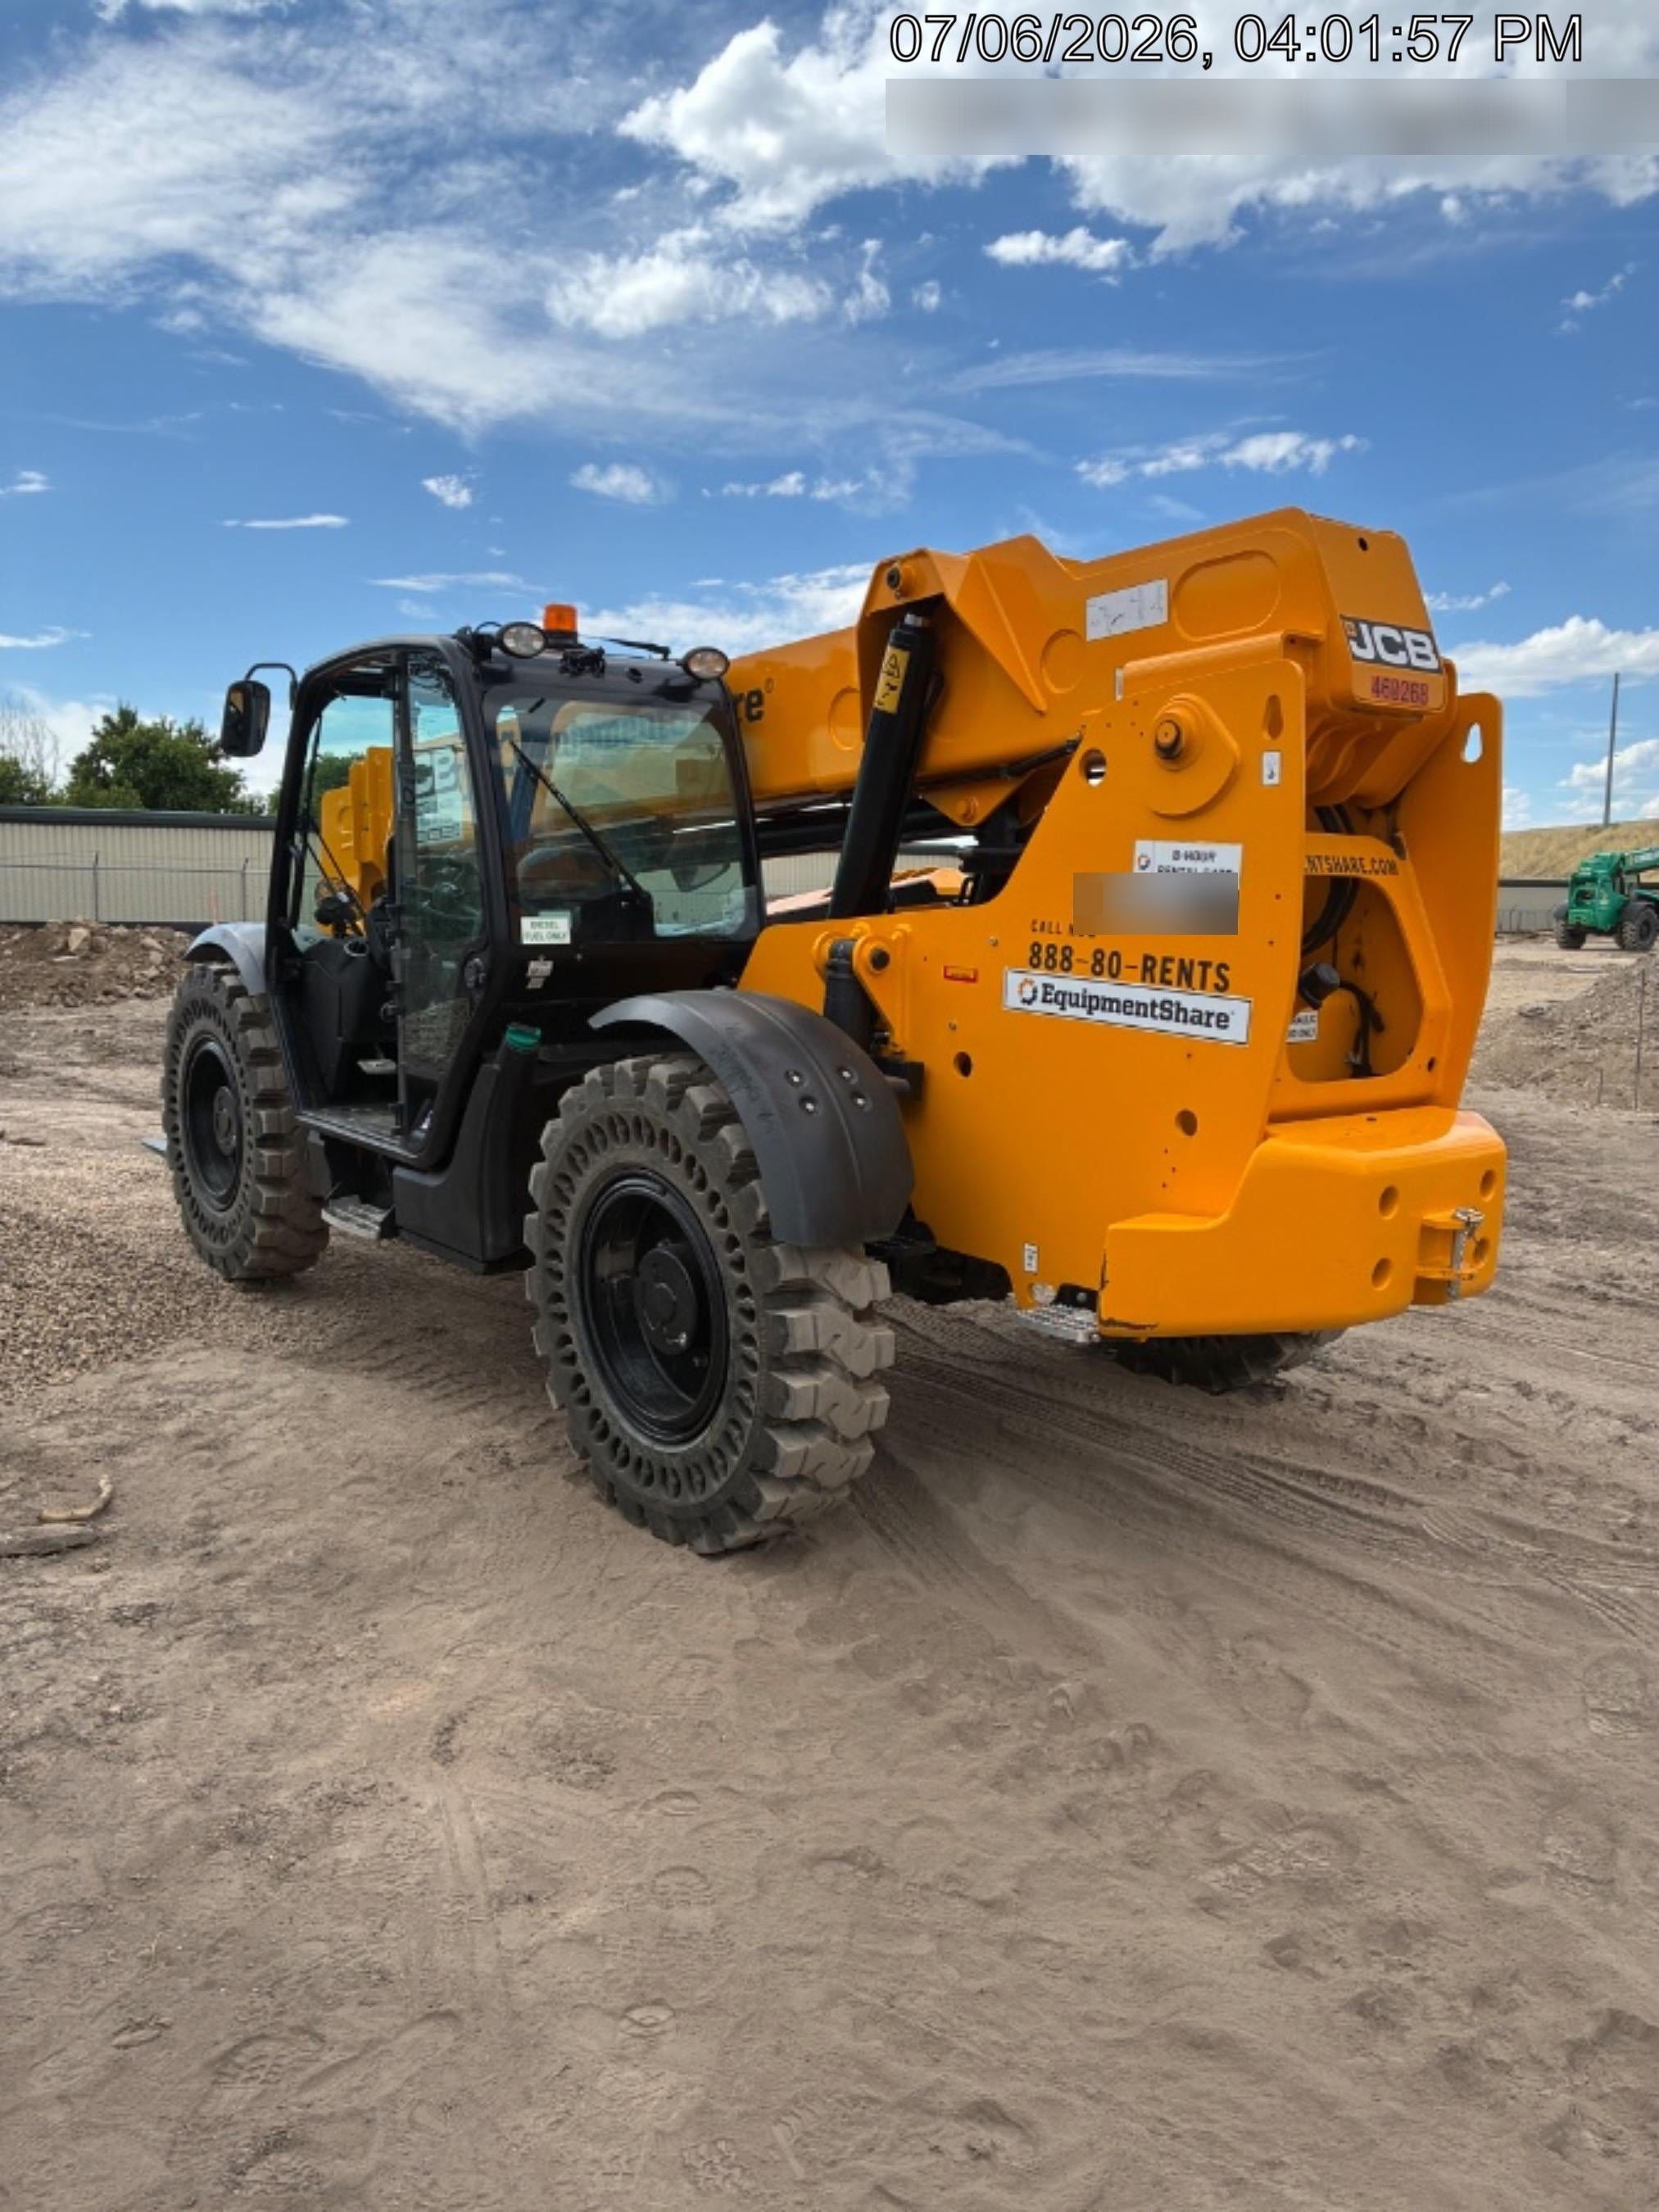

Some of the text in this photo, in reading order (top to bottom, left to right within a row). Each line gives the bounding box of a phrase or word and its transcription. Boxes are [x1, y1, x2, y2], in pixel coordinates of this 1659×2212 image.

[1349, 622, 1439, 670] JCB
[1029, 941, 1231, 994] 888-80-RENTS
[1041, 982, 1230, 1030] EquipmentShare
